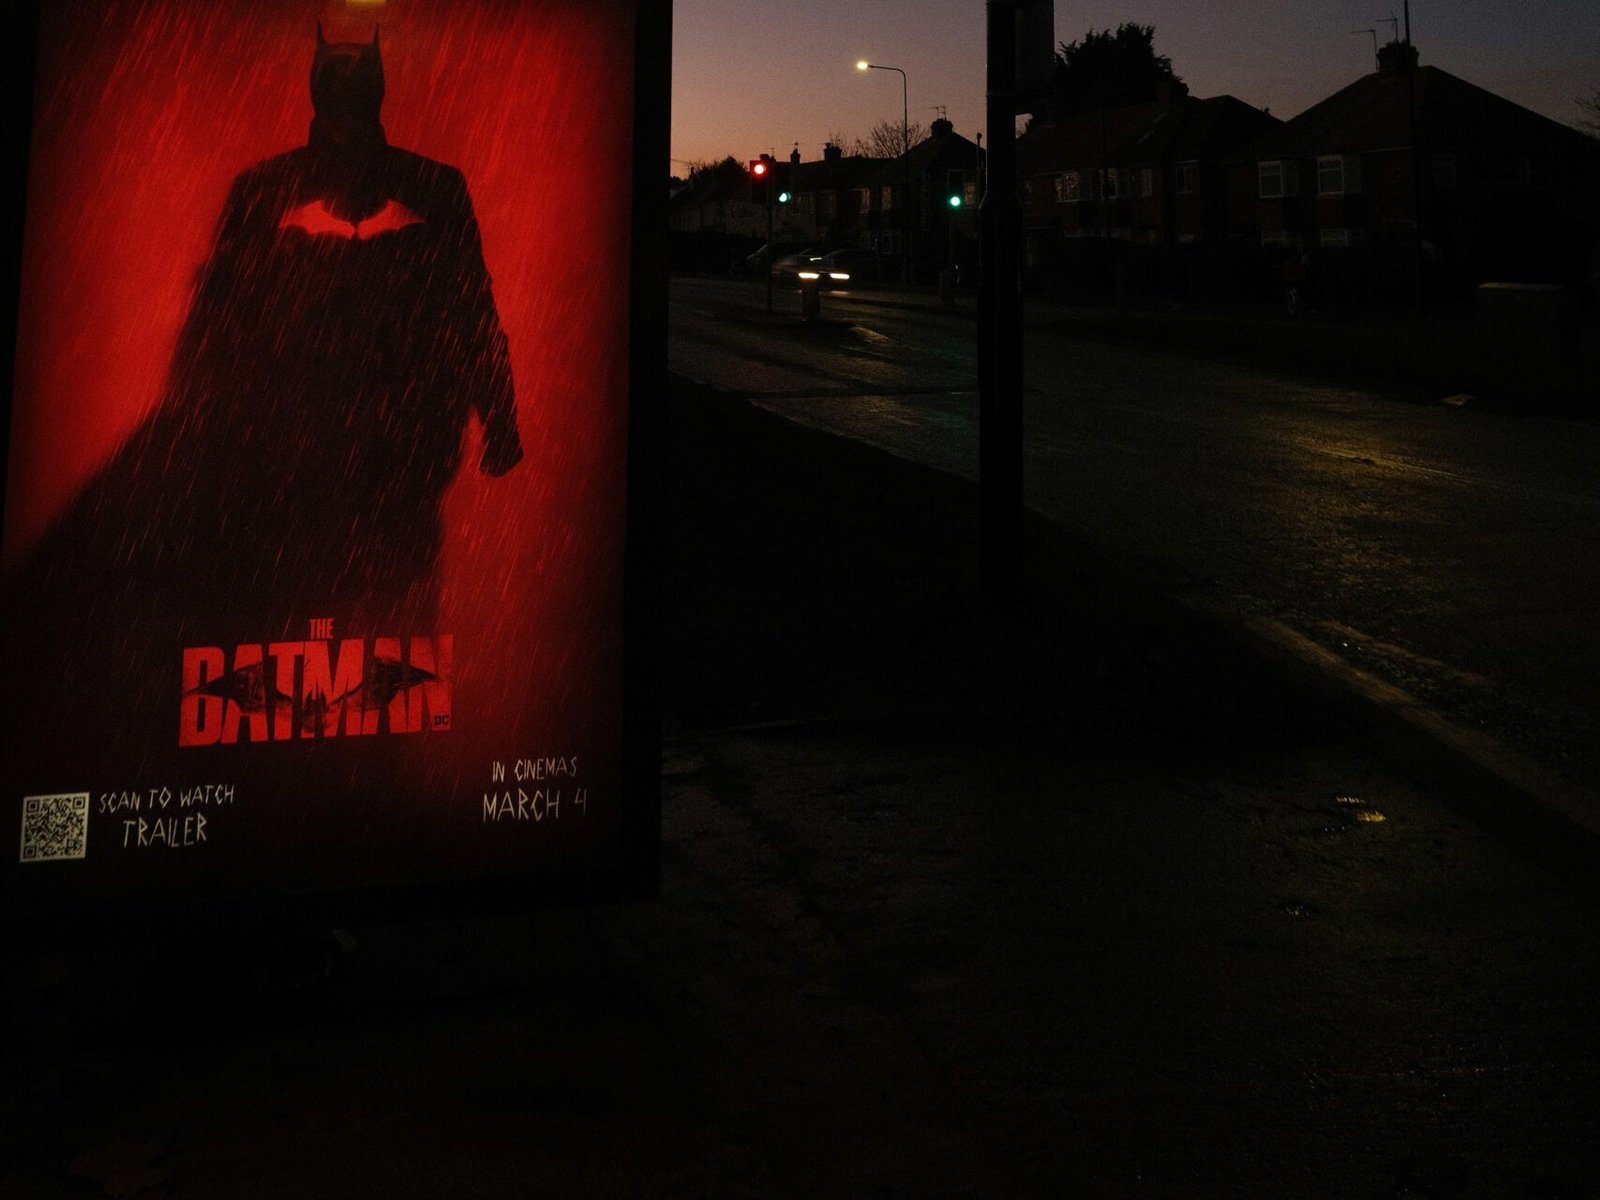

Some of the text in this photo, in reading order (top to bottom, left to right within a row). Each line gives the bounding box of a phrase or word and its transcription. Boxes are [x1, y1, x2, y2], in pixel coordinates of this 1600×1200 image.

[308, 617, 334, 640] THE
[179, 633, 453, 748] BATMAN
[434, 714, 450, 726] DC
[492, 755, 577, 783] IN CINEMAS
[98, 784, 235, 814] SCAN TO WATCH
[483, 787, 587, 824] MARCH 4
[123, 812, 208, 848] TRAILER
